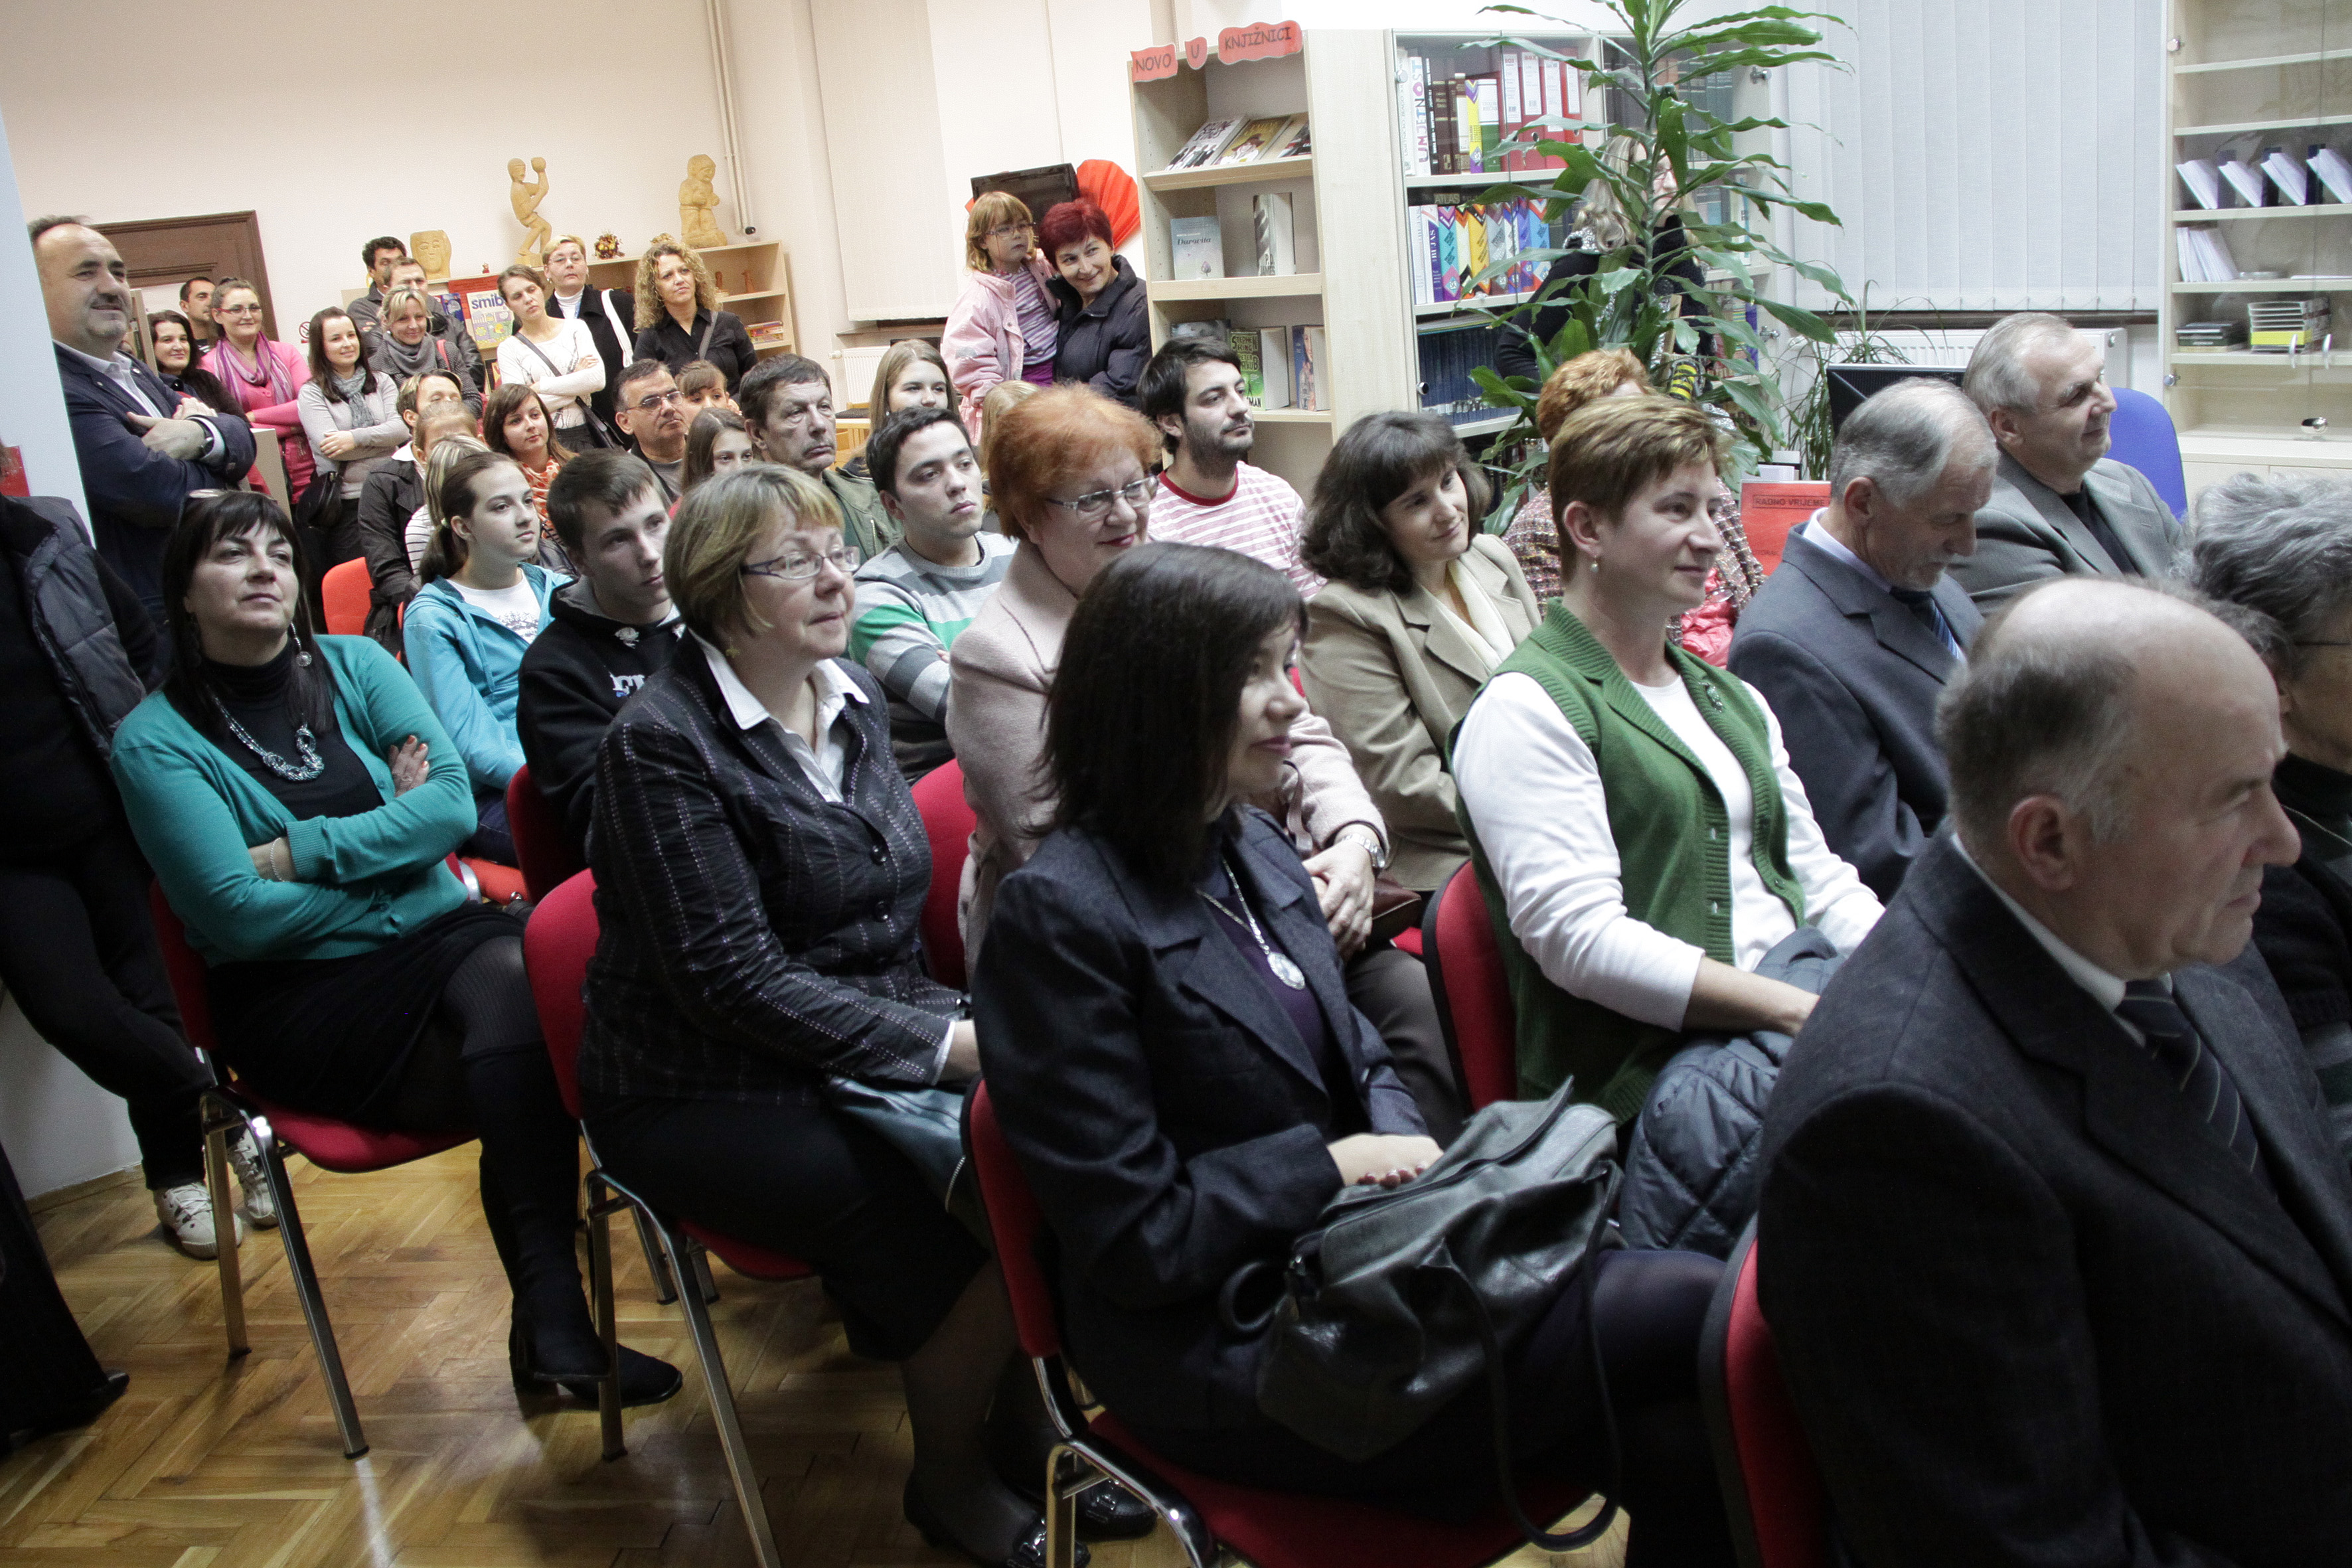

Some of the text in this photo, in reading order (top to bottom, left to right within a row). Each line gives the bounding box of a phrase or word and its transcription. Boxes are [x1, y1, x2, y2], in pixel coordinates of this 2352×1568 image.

[1135, 27, 1292, 73] NOVO U KNJIŽNICI
[1411, 60, 1429, 163] UMJETNOST
[1434, 193, 1460, 204] ATLAS
[471, 293, 505, 309] smib
[1231, 335, 1259, 351] STEPHEN
